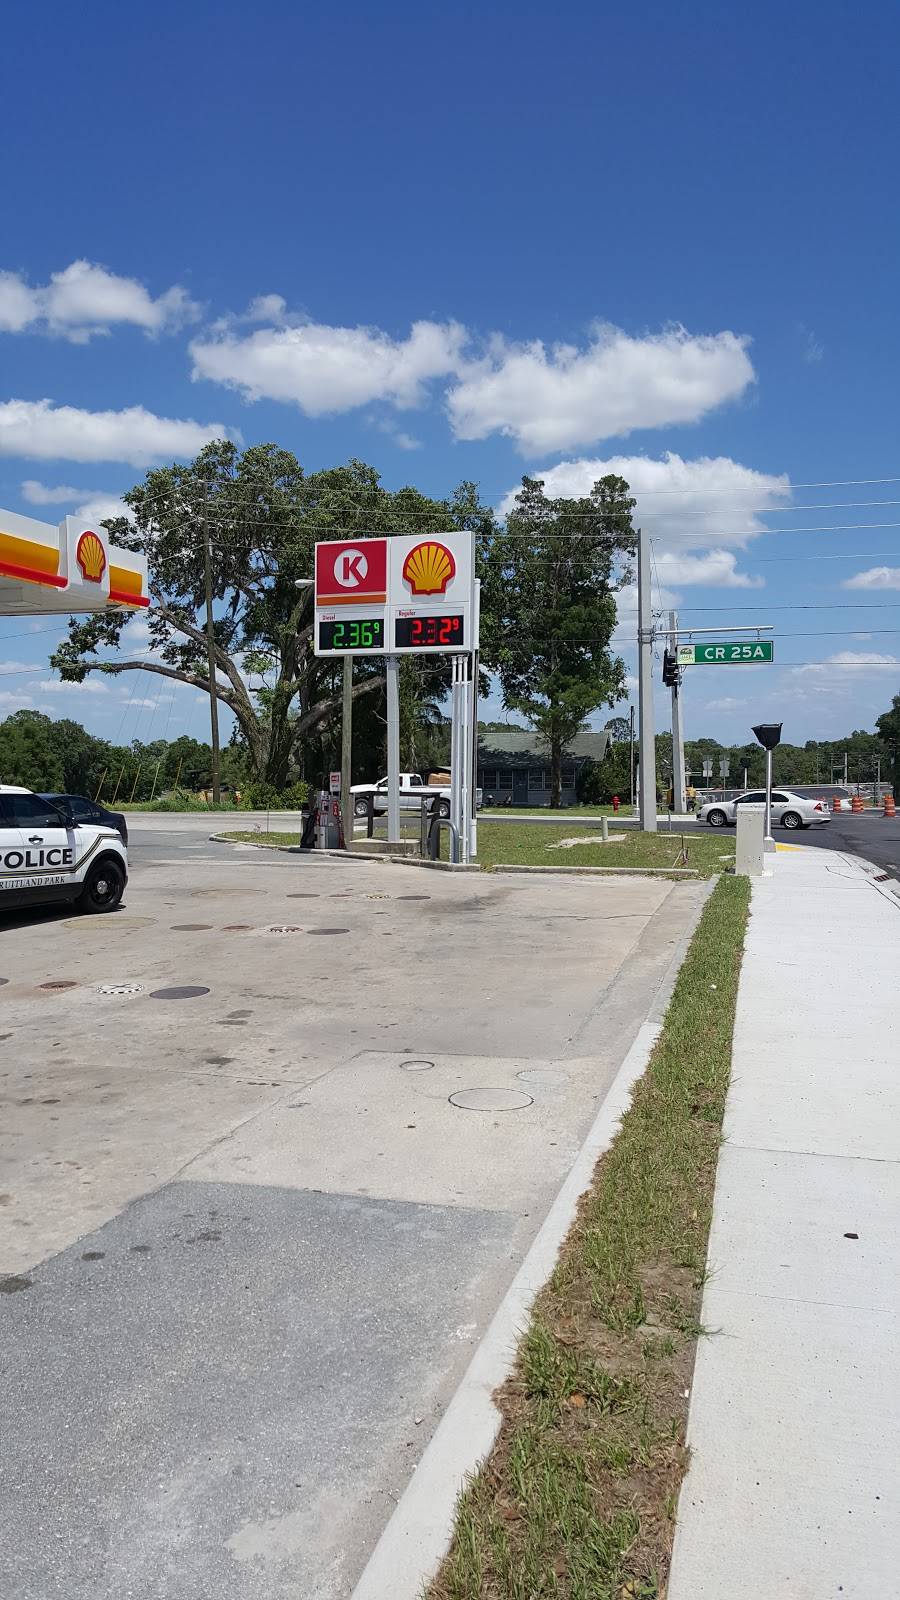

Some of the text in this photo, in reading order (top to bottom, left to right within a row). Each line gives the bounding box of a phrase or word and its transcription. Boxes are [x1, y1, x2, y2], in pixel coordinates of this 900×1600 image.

[343, 556, 365, 584] K
[322, 613, 336, 621] Diesel
[398, 609, 416, 617] Regular
[704, 647, 726, 659] CR
[731, 646, 765, 658] 25A
[0, 848, 73, 869] OLICE
[44, 876, 65, 885] PARK
